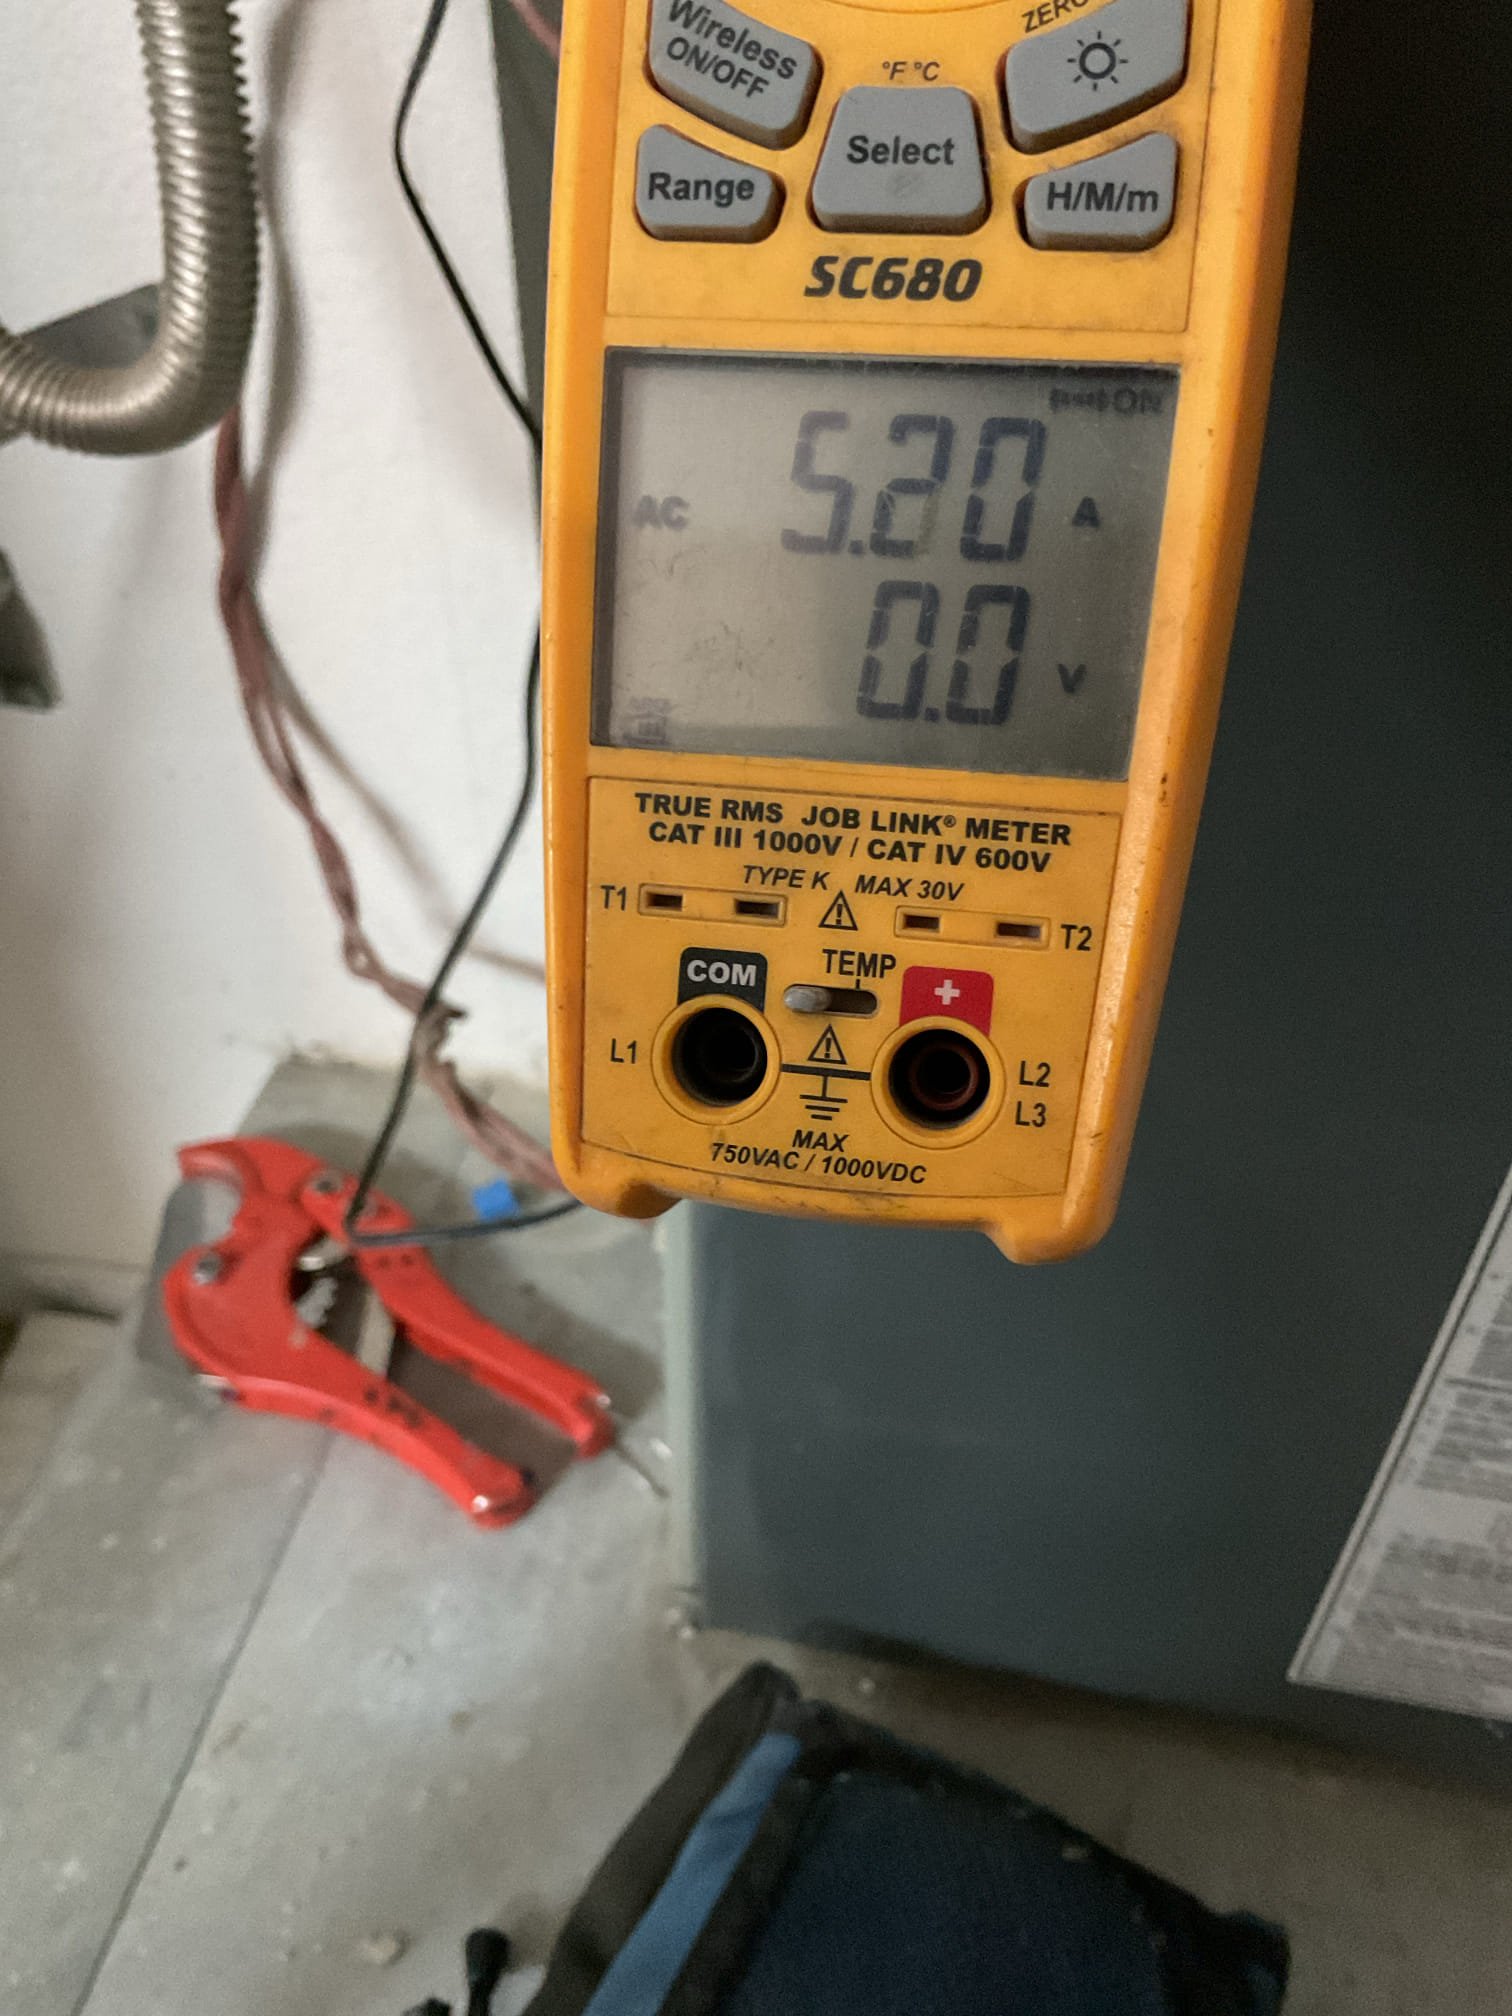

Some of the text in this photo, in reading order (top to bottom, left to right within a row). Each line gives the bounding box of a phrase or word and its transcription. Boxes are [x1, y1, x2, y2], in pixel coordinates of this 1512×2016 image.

[669, 0, 797, 79] Wireless
[667, 37, 769, 97] ON/OFF
[847, 136, 954, 165] Select
[648, 172, 755, 207] Range
[1047, 182, 1158, 213] H/M/m
[803, 256, 982, 301] SC680
[781, 410, 1046, 561] 5.20
[633, 496, 688, 529] AC
[1073, 496, 1100, 527] A
[856, 579, 1031, 725] 0.0
[635, 792, 711, 818] TRUE
[721, 799, 783, 824] RMS
[801, 806, 861, 831] JOB
[965, 818, 1071, 846] METER
[649, 821, 704, 845] CAT
[714, 827, 742, 849] III
[753, 829, 842, 857] 1000V
[867, 838, 925, 863] CAT
[936, 843, 965, 866] IV
[975, 848, 1051, 873] 600V
[600, 885, 627, 911] T1
[743, 864, 964, 902] TYPE K MAX 30V
[1061, 924, 1093, 951] T2
[687, 959, 757, 987] COM
[823, 948, 897, 979] TEMP
[610, 1038, 637, 1065] L1
[1020, 1061, 1051, 1088] L2
[1015, 1101, 1046, 1127] L3
[792, 1129, 849, 1153] MAX
[710, 1142, 799, 1170] 750VAC
[822, 1156, 927, 1184] 1000VDC
